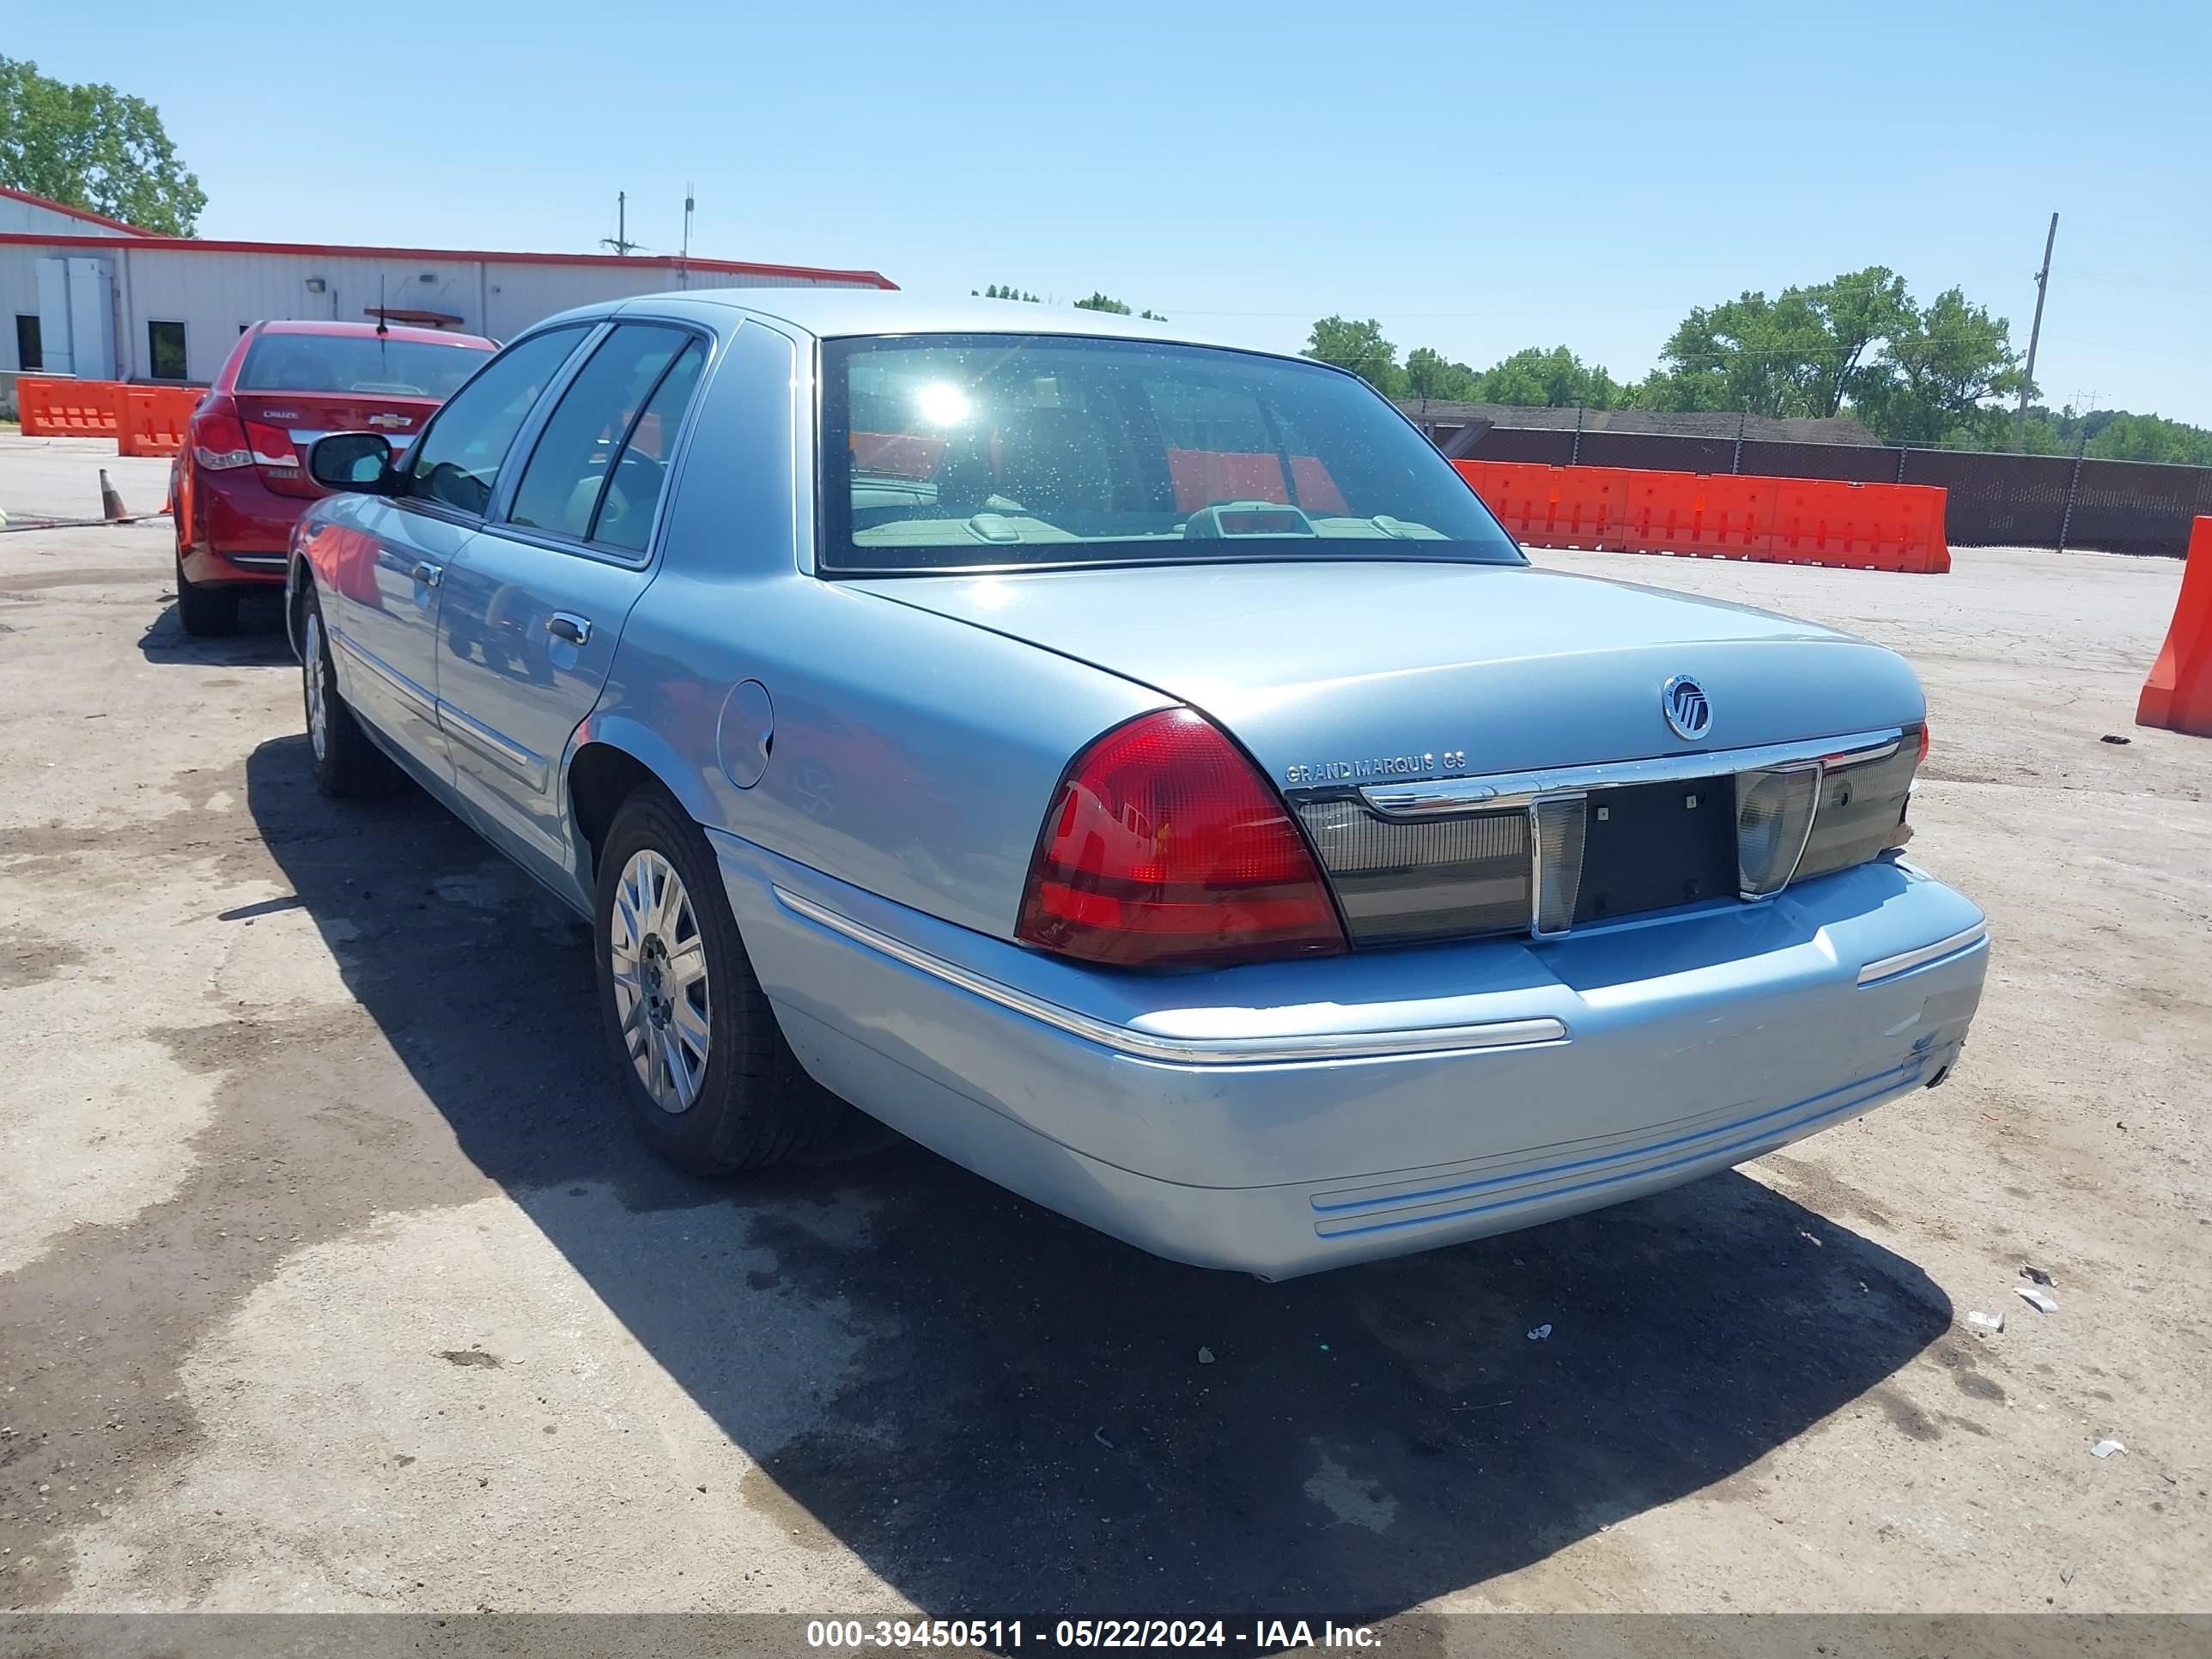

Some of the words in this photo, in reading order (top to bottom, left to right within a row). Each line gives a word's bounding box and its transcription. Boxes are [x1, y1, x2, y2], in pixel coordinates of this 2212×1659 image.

[263, 410, 300, 420] CRUZE
[1285, 762, 1352, 783] GRAND
[1354, 751, 1435, 777] MARQUIS
[1442, 750, 1467, 769] GS
